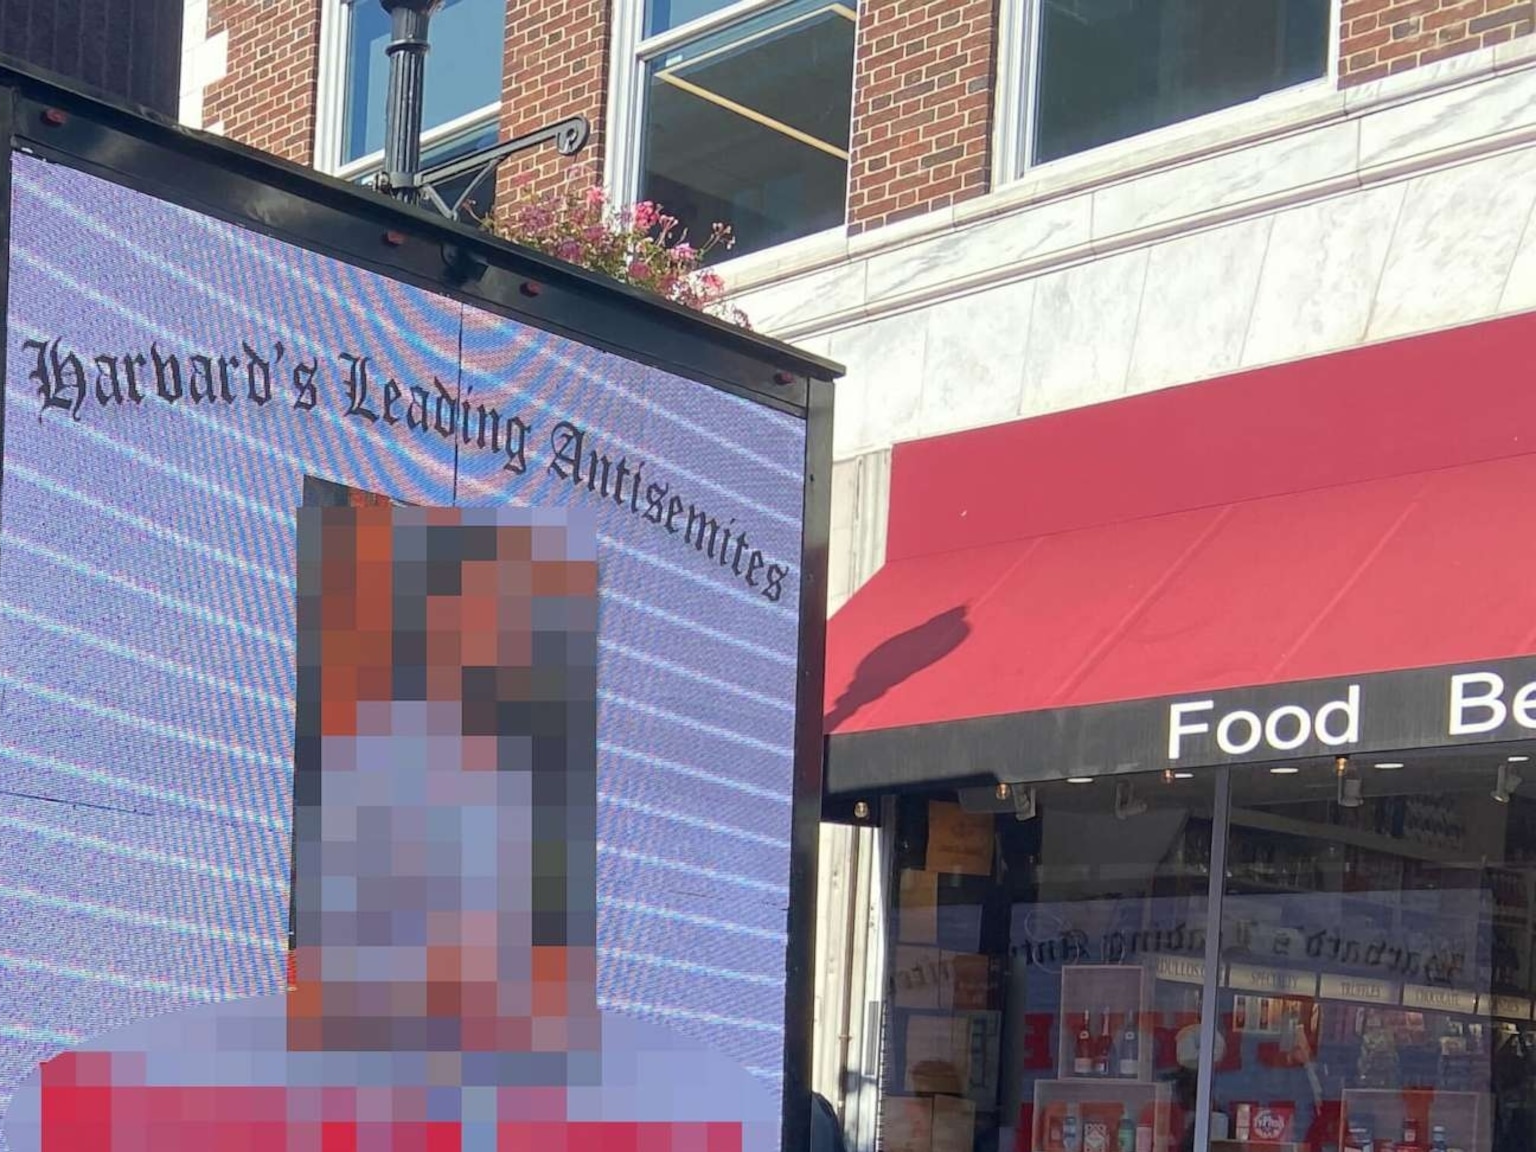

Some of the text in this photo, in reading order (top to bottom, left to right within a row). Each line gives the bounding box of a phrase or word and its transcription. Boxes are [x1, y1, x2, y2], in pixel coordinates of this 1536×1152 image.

[23, 338, 790, 606] Harvard's Leading Antisemites
[1168, 684, 1360, 760] Food
